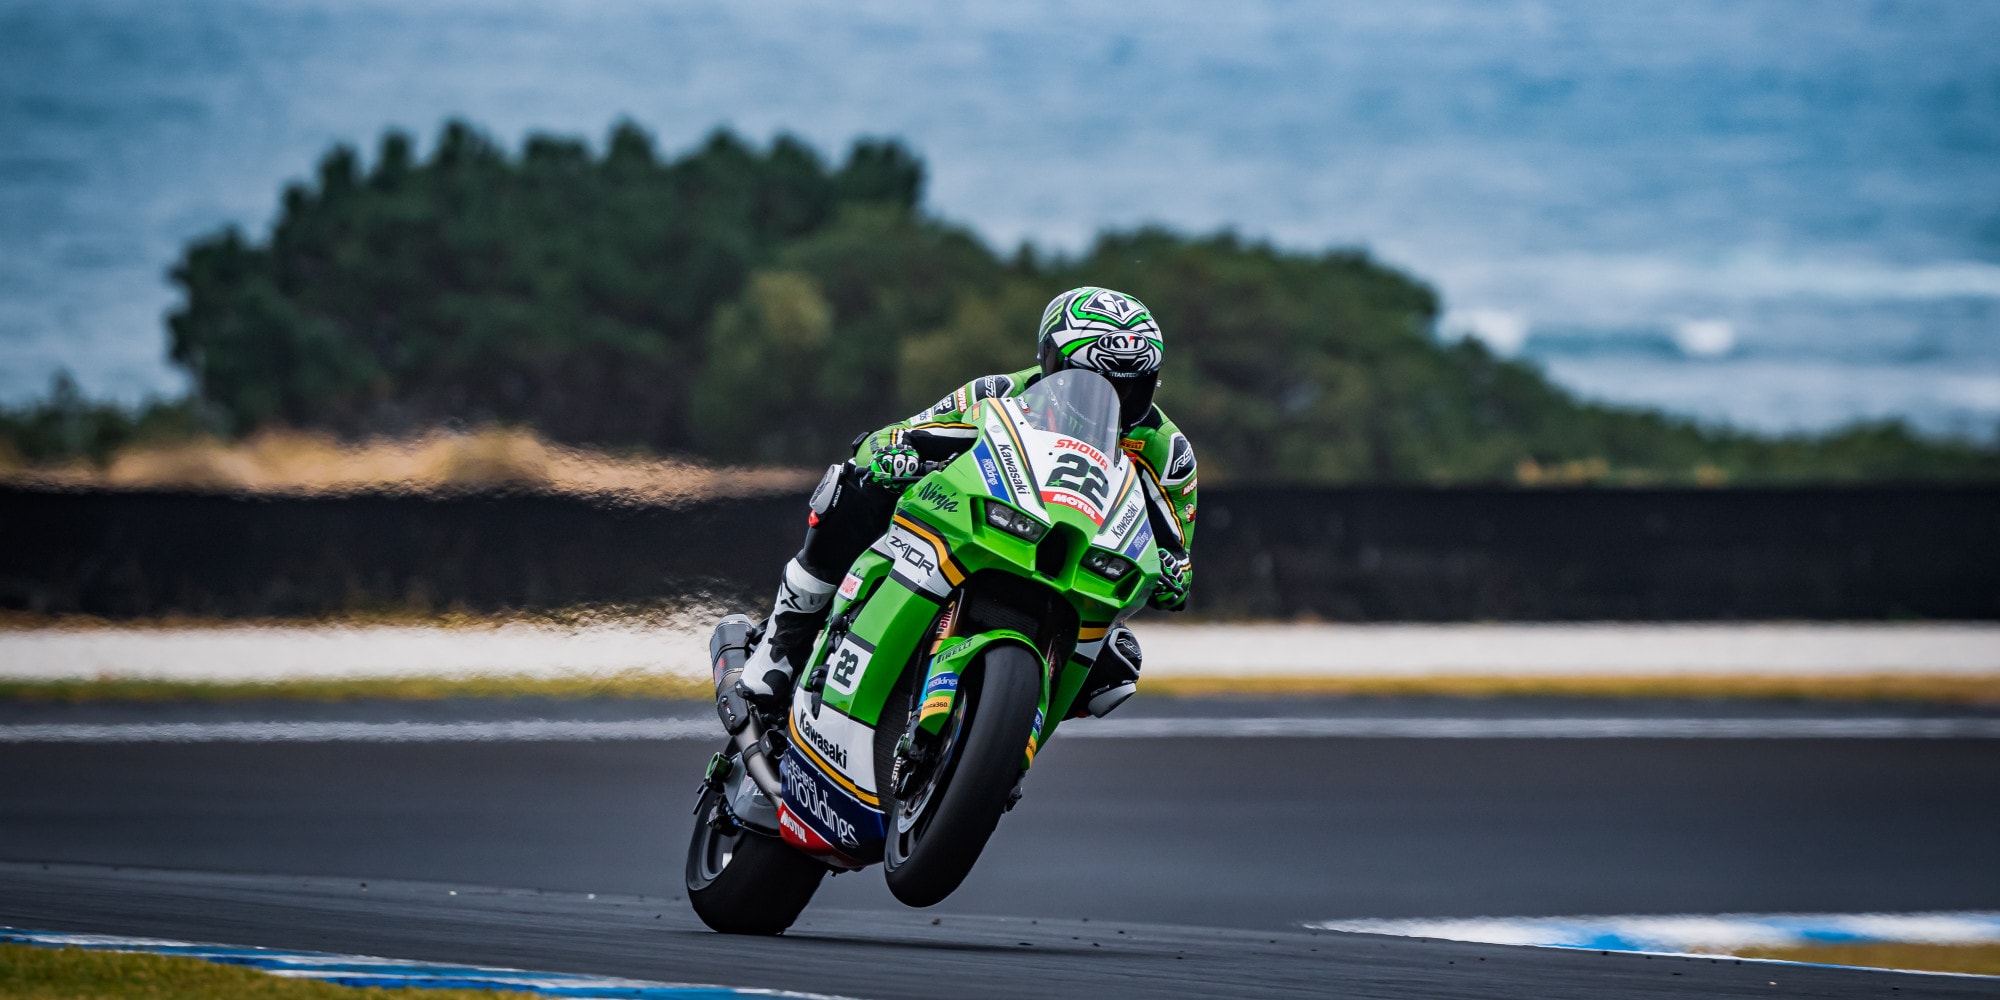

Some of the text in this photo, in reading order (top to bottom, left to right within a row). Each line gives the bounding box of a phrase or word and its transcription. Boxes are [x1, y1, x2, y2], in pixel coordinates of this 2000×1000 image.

[1101, 336, 1142, 349] KYT
[998, 444, 1031, 494] Kawasaki
[1053, 438, 1108, 471] SHOWA
[918, 481, 958, 513] Ninja
[1045, 453, 1110, 512] 22
[1052, 493, 1097, 520] MOTUL
[1110, 500, 1139, 540] Kawasaki
[832, 648, 859, 689] 22
[936, 638, 973, 665] PIRELLI
[799, 707, 848, 770] Kawasaki
[780, 810, 808, 844] MOTUL
[787, 769, 860, 848] mouldings
